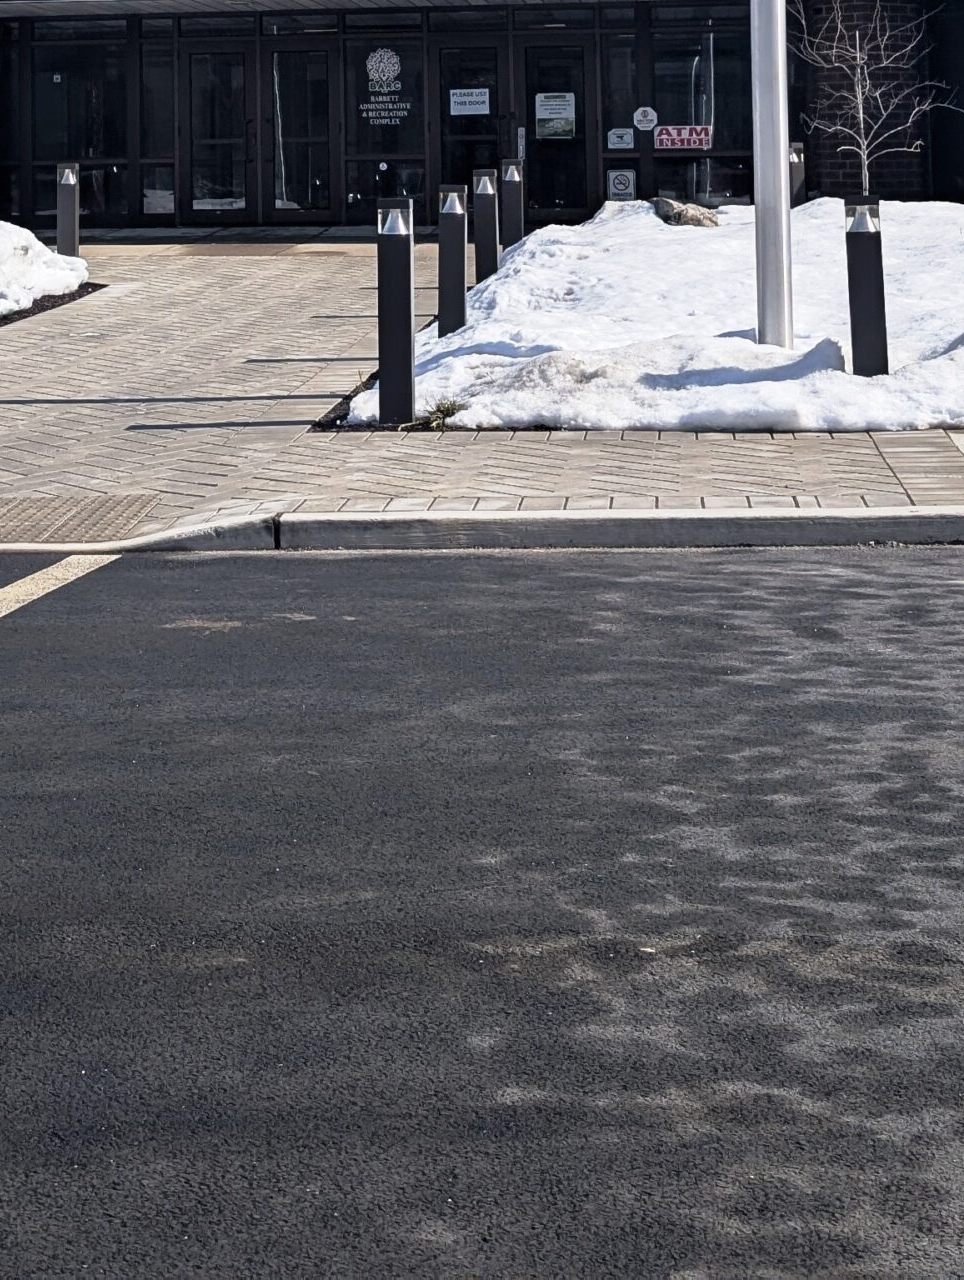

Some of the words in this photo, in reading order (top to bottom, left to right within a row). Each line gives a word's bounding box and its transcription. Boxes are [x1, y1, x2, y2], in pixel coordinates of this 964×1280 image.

[369, 81, 401, 91] BARC
[359, 102, 411, 110] ADMINISTRATIVE
[656, 127, 710, 137] ATM
[657, 138, 709, 147] INSIDE
